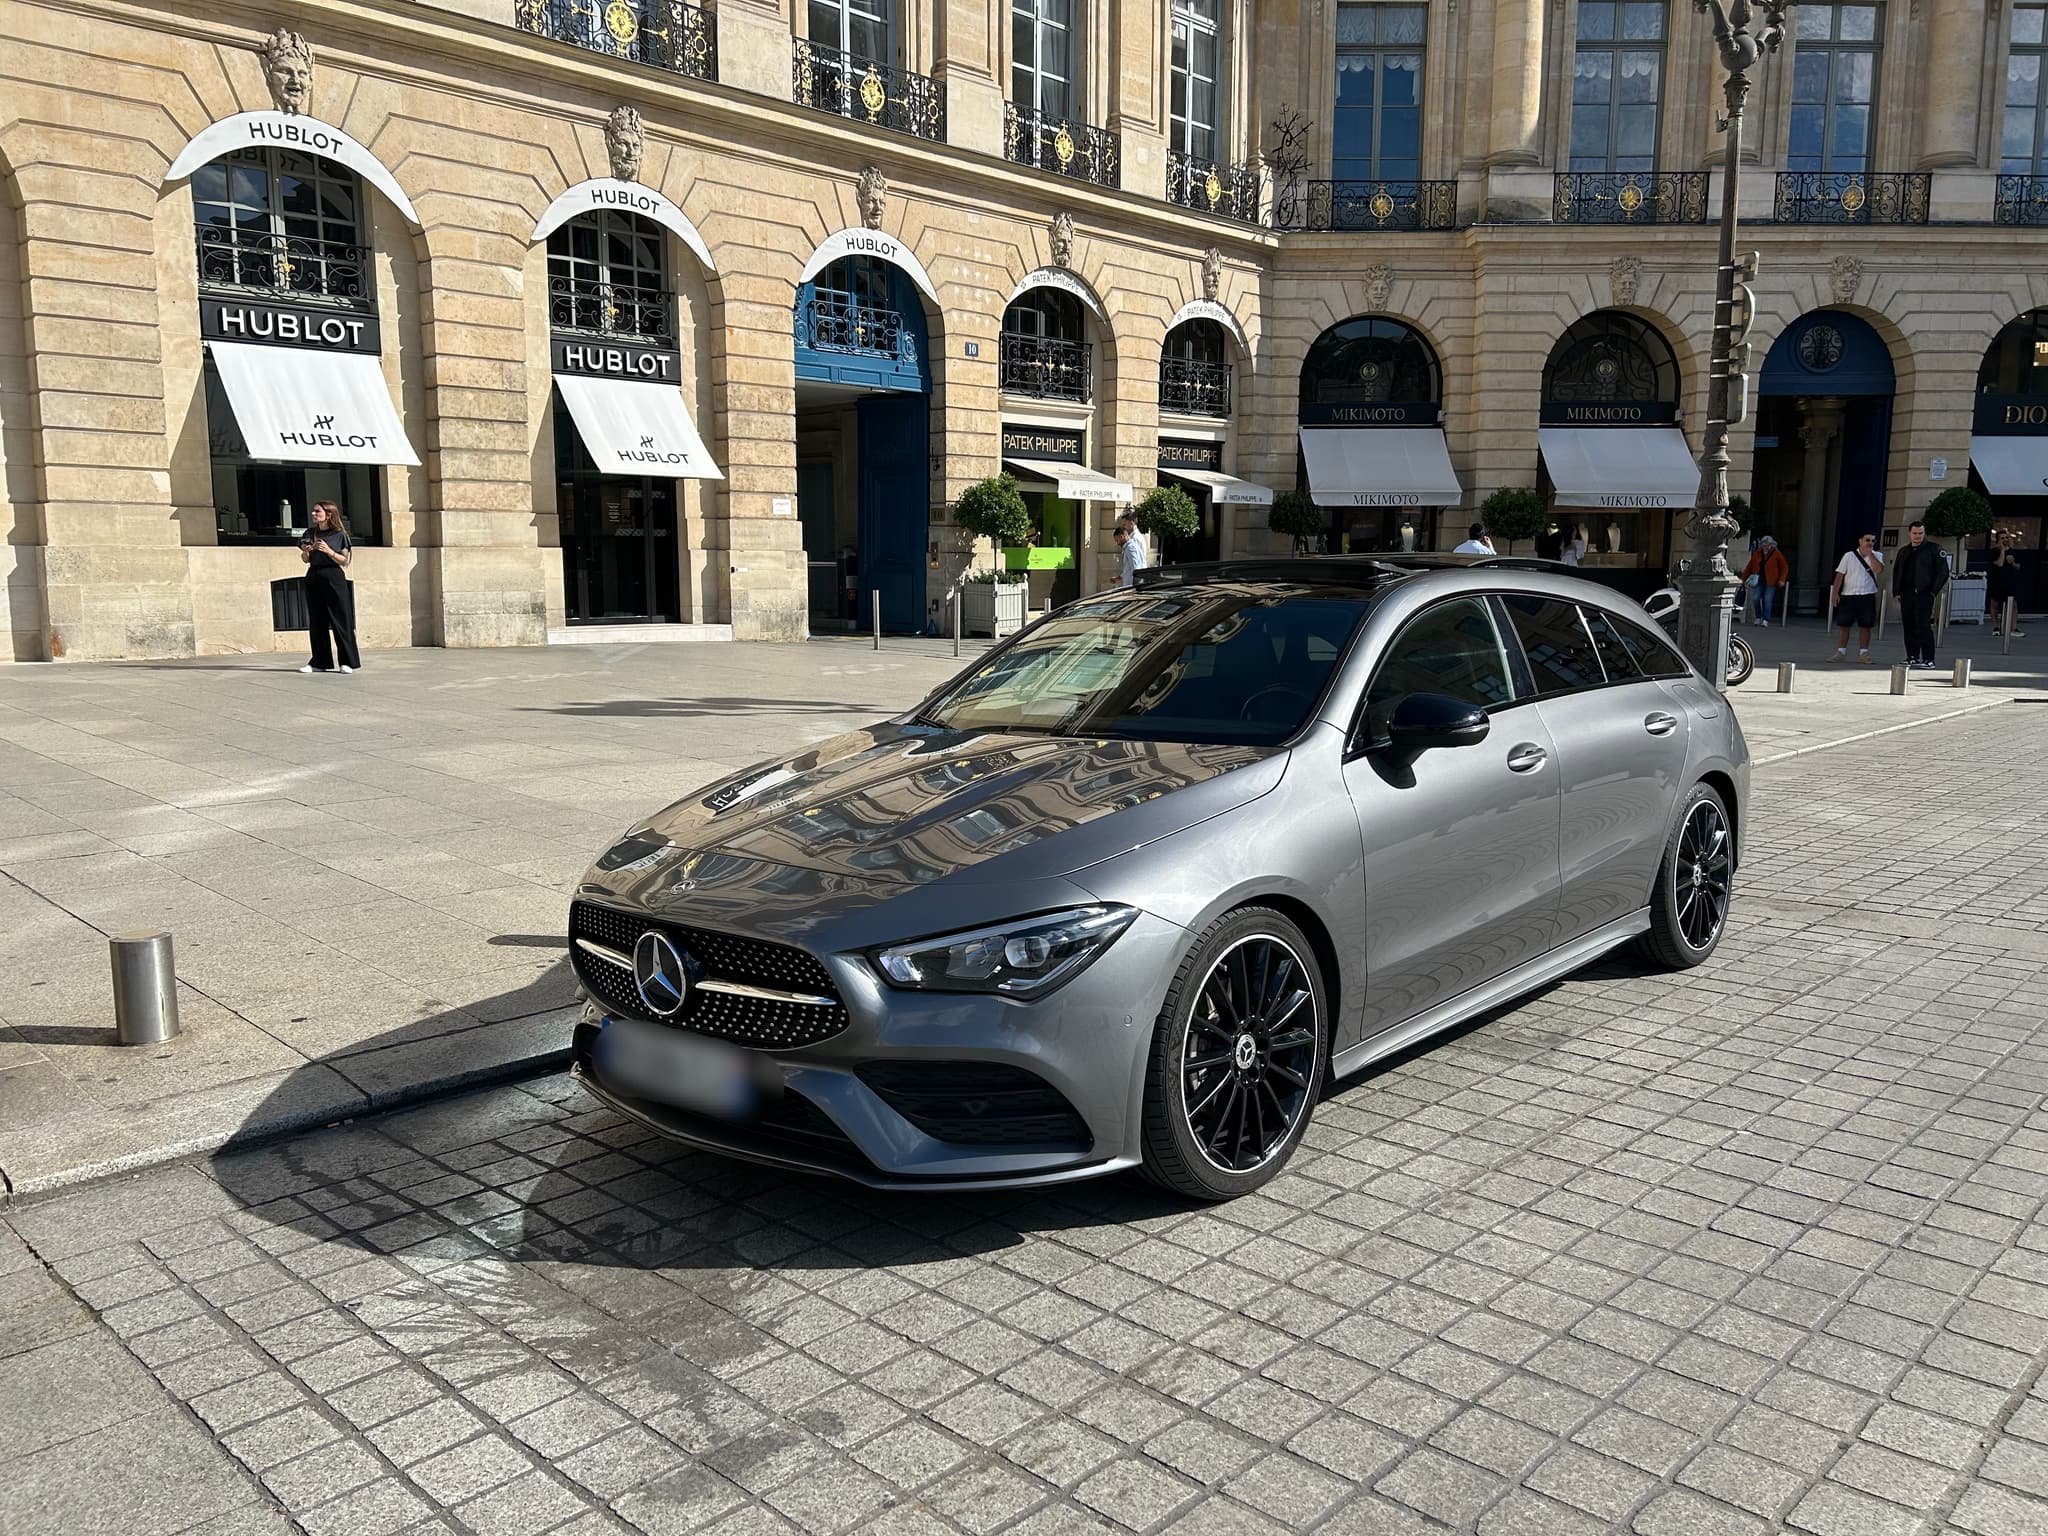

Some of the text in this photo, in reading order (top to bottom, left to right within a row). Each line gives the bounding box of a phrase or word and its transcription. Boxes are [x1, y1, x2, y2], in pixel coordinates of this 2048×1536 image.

[249, 122, 343, 155] HUBLOT
[591, 189, 660, 215] HUBLOT
[846, 238, 898, 258] HUBLOT
[1032, 273, 1051, 284] PATEK
[221, 306, 365, 346] HUBLOT
[968, 343, 977, 355] 10
[566, 345, 671, 377] HUBLOT
[1331, 408, 1406, 421] MIKIMOTO
[1567, 407, 1641, 420] MIKIMOTO
[2004, 405, 2048, 424] DIO
[280, 432, 378, 449] HUBLOT
[1003, 433, 1078, 454] PATEK PHILIPPE
[617, 450, 689, 465] HUBLOT
[1157, 446, 1217, 463] PATEK PHILIPPE
[1352, 494, 1419, 505] MIKIMOTO
[1599, 495, 1667, 507] MIKIMOTO
